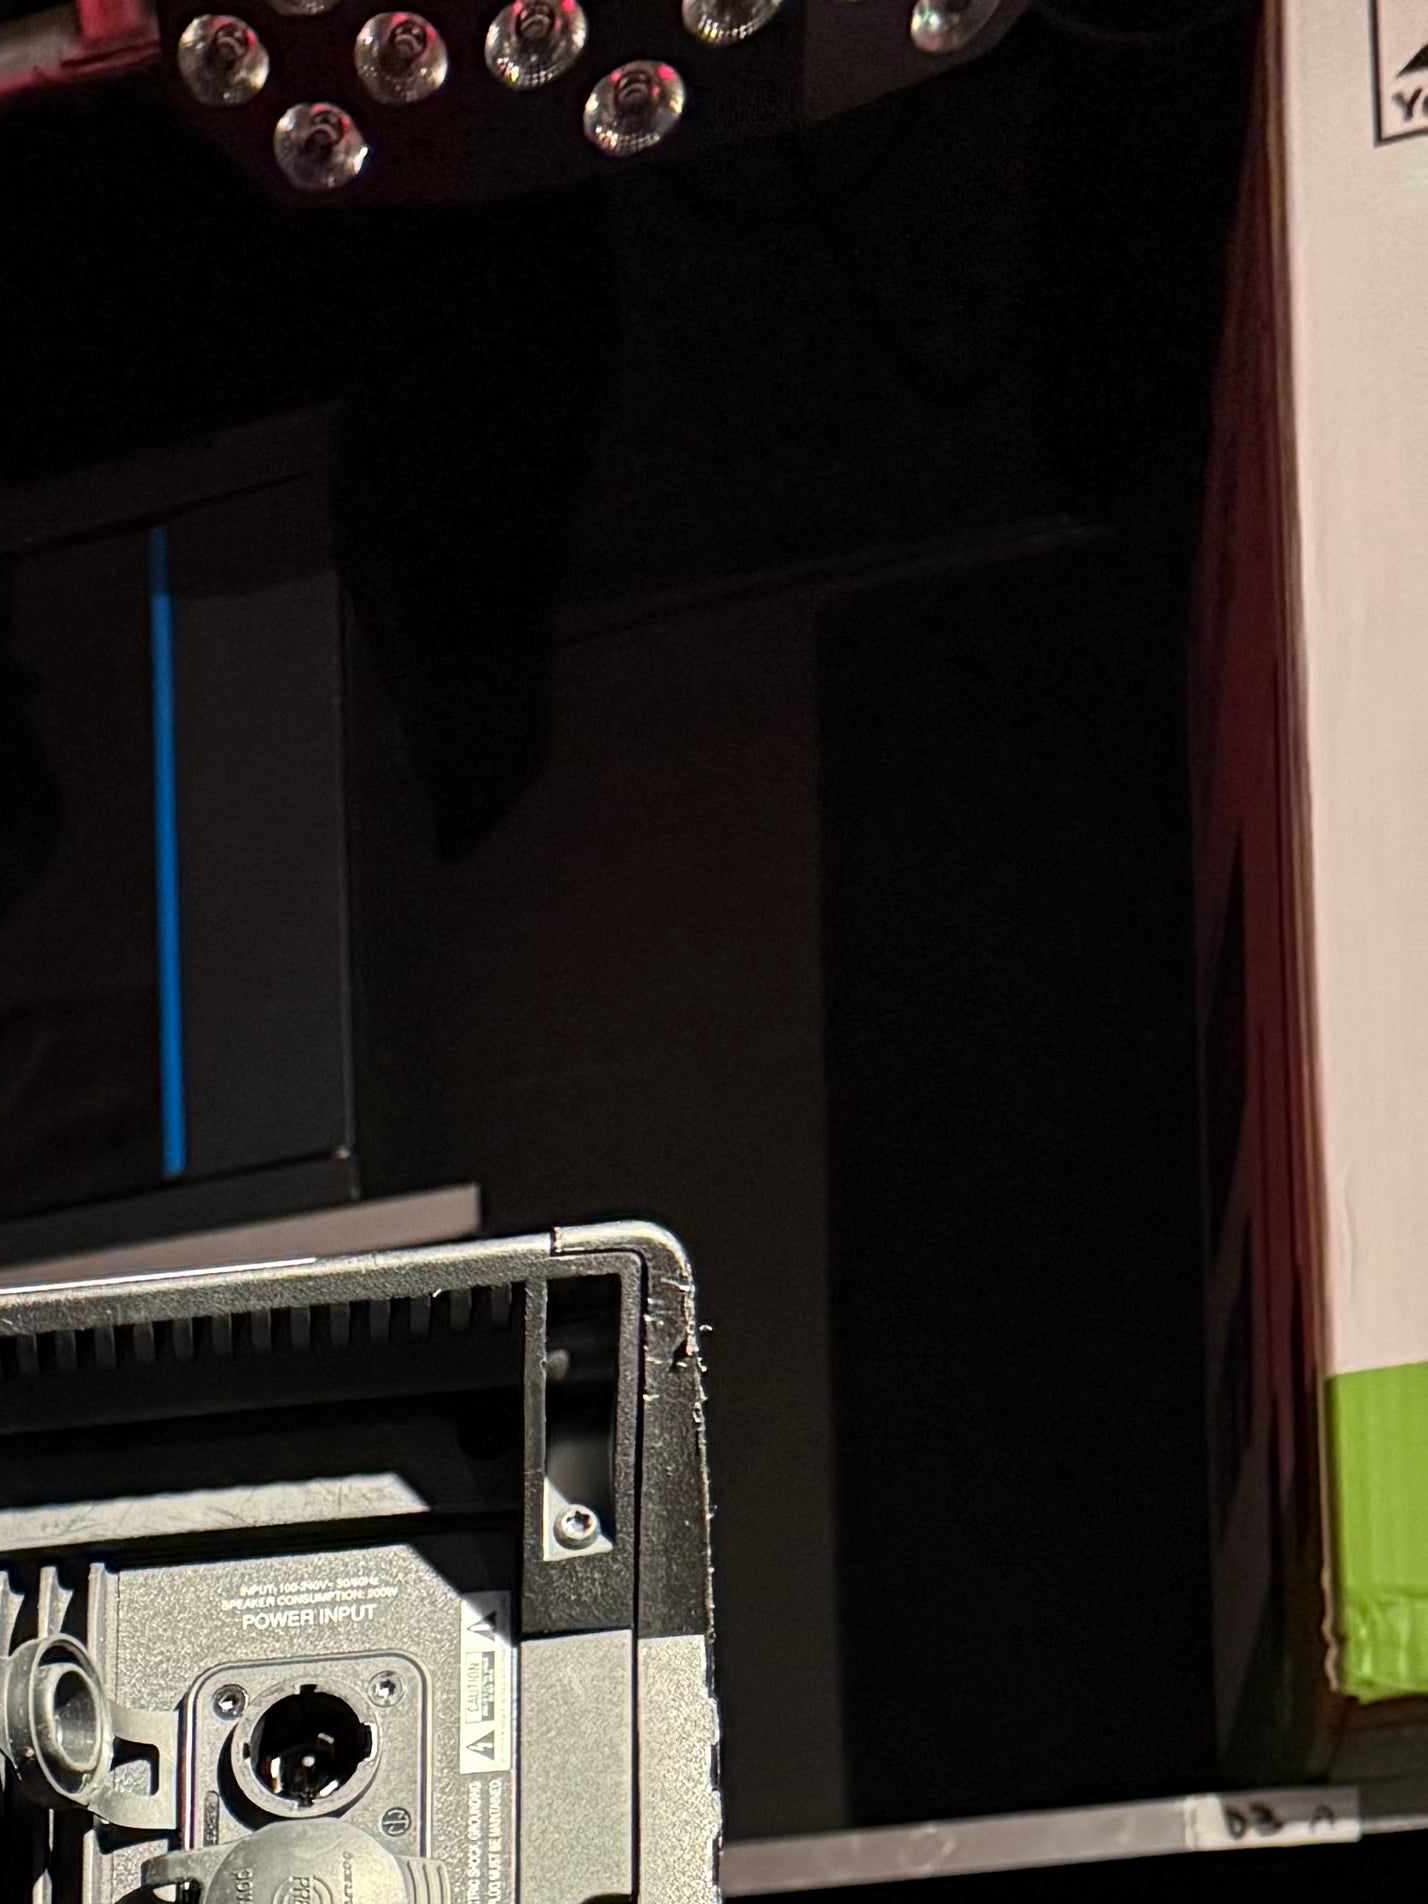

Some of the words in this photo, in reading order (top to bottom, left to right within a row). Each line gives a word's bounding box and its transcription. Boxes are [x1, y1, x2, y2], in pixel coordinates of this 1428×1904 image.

[222, 1595, 275, 1611] SPEAKER
[277, 1590, 365, 1606] CONSUMPTION:
[242, 1608, 314, 1630] POWER
[318, 1603, 378, 1625] INPUT
[467, 1662, 479, 1712] CAUTION
[468, 1781, 481, 1840] GROUNDING
[489, 1838, 502, 1852] BE
[489, 1854, 501, 1880] MUST
